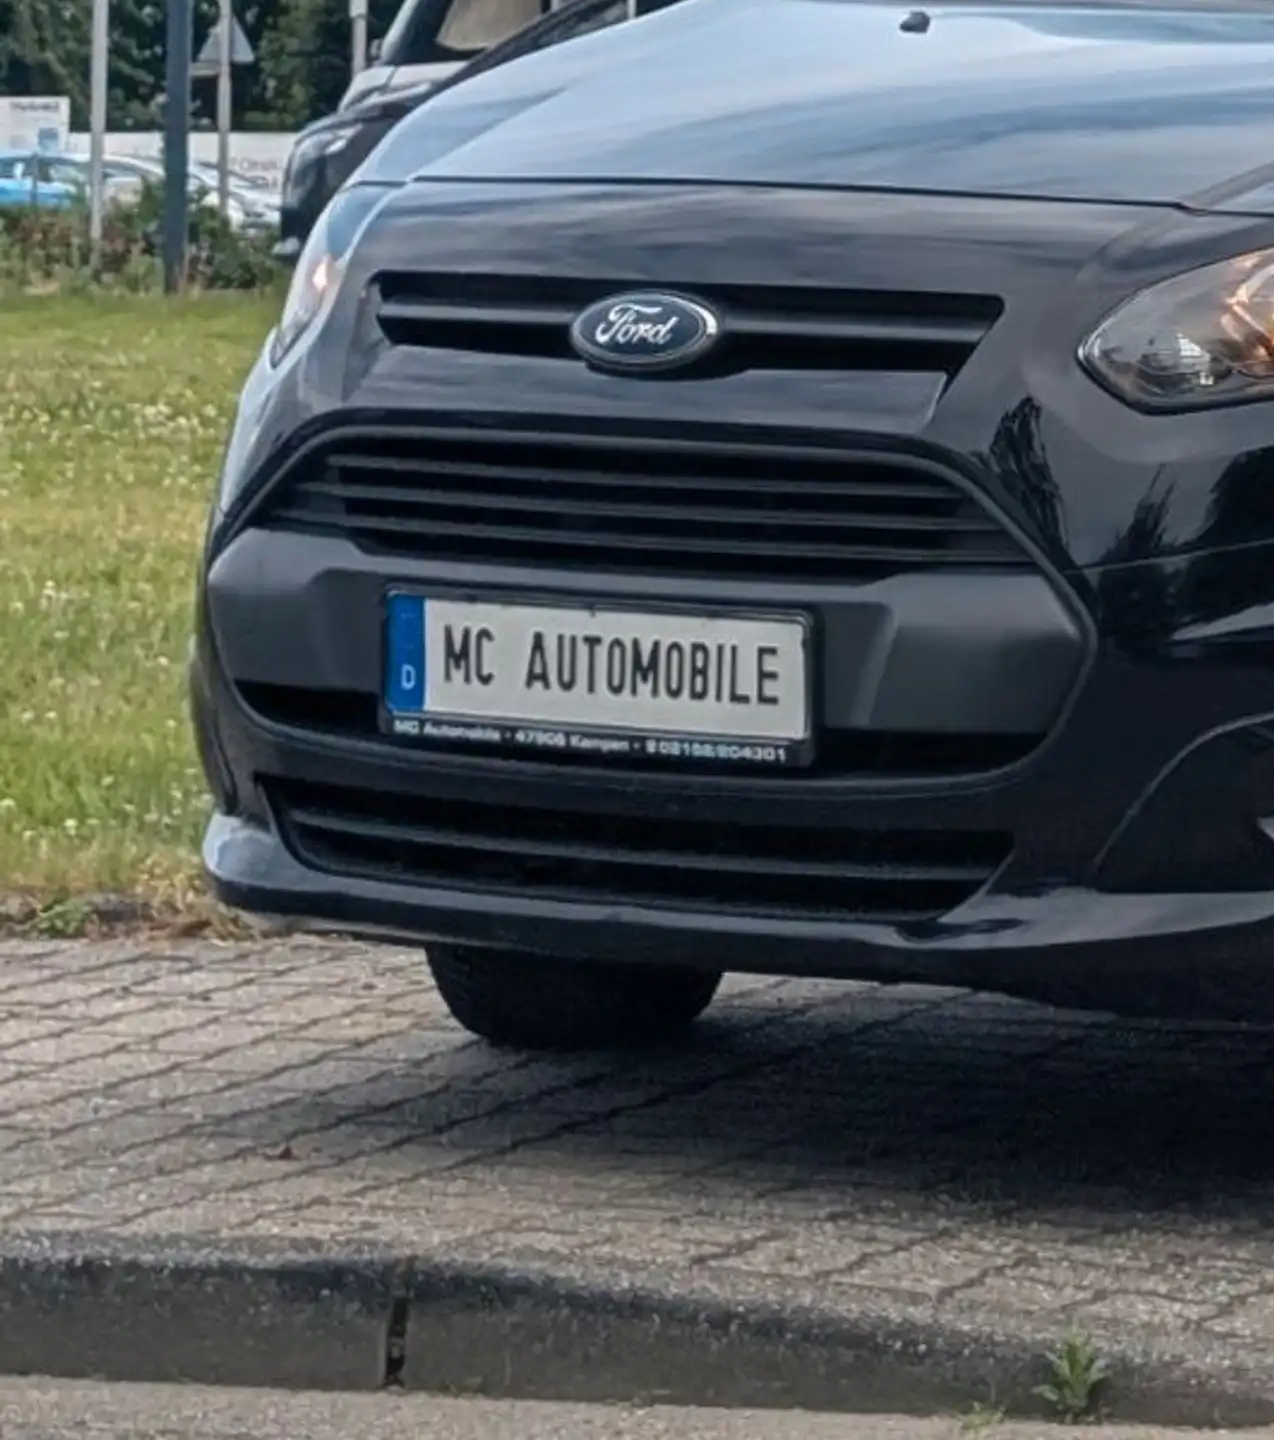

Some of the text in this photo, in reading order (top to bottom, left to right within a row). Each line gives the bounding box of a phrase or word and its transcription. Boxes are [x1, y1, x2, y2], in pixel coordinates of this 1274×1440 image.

[595, 303, 680, 345] Ford
[401, 665, 416, 690] D
[443, 624, 780, 706] MC AUTOMOBILE
